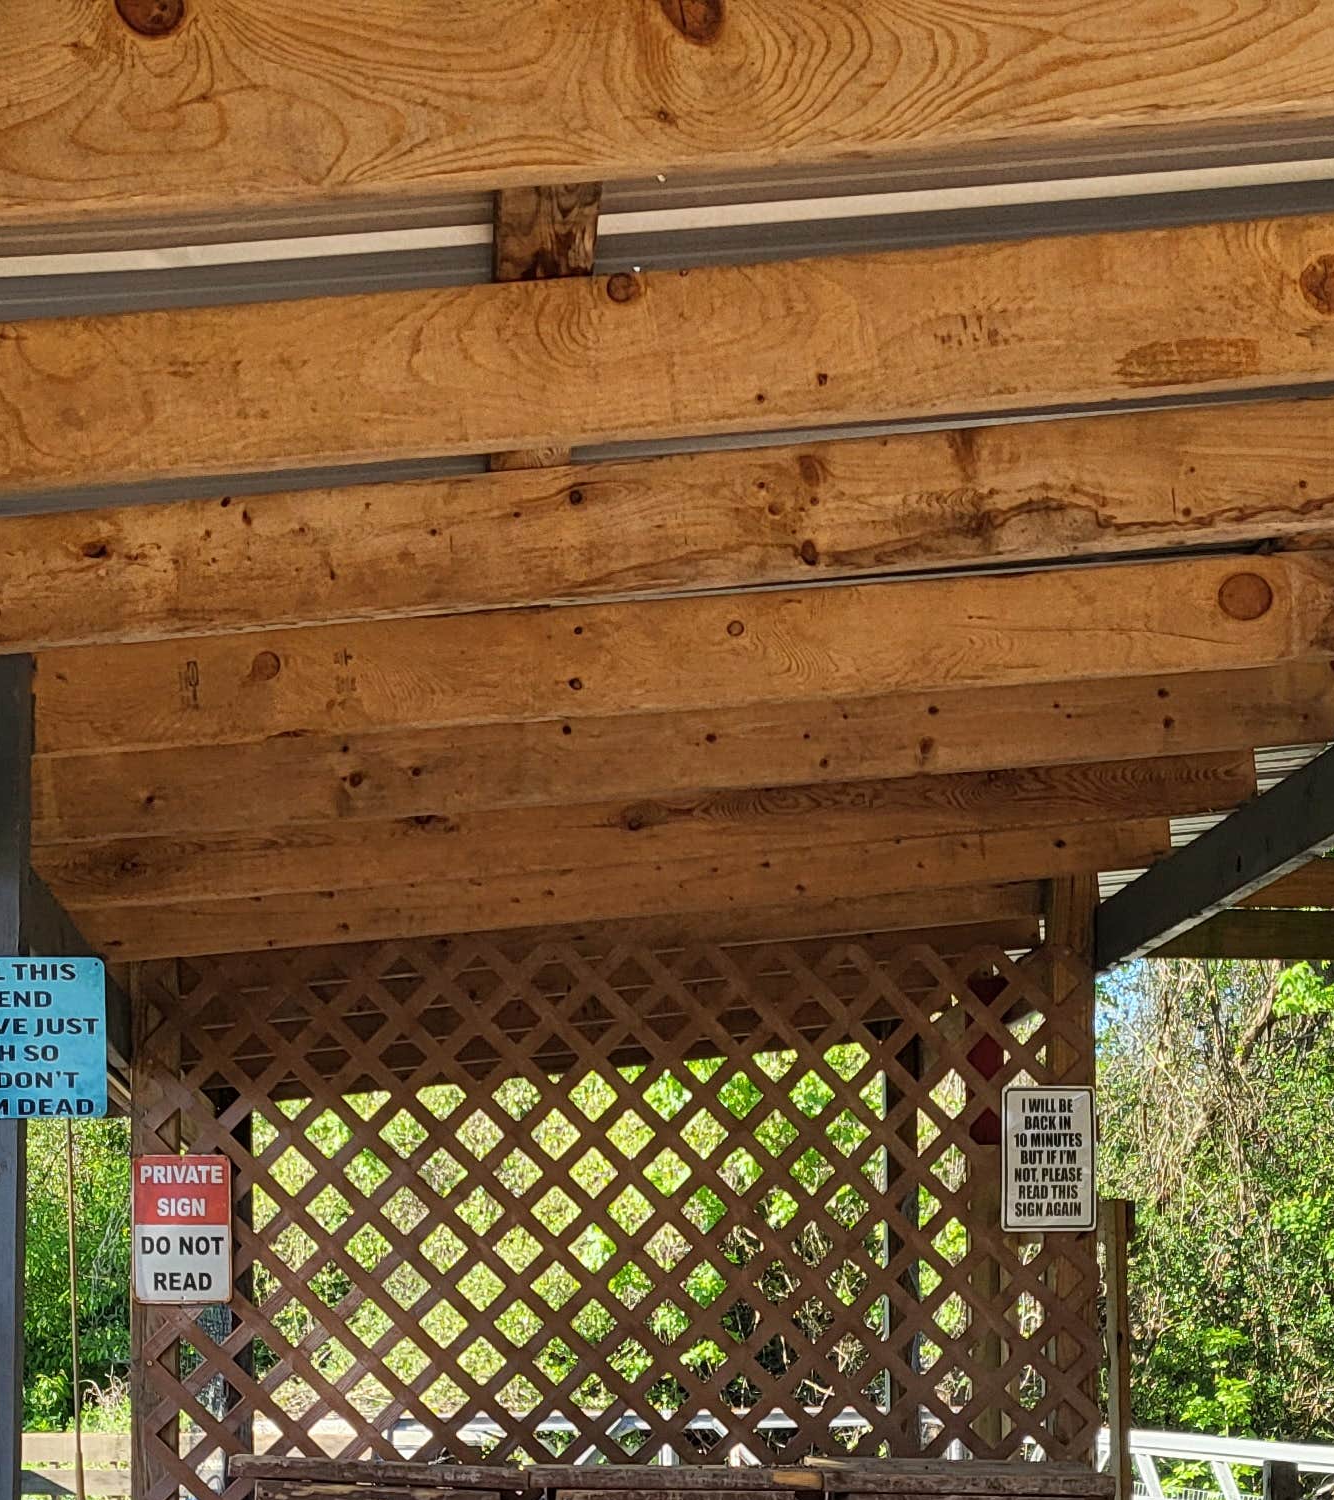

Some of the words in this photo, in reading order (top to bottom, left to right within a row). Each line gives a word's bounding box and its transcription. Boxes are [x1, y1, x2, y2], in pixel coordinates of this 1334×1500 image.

[12, 963, 76, 981] THIS
[34, 1018, 99, 1037] JUST
[24, 1045, 59, 1062] SO
[18, 1099, 94, 1116] DEAD
[1022, 1098, 1025, 1113] I
[1029, 1098, 1056, 1113] WILL
[1059, 1099, 1073, 1113] BE
[1025, 1116, 1056, 1130] BACK
[1059, 1116, 1071, 1130] IN
[1014, 1133, 1027, 1147] 10
[1031, 1133, 1082, 1147] MINUTES
[1021, 1150, 1044, 1164] BUT
[1047, 1150, 1056, 1164] IF
[140, 1165, 223, 1184] PRIVATE
[1015, 1168, 1038, 1183] NOT,
[1042, 1168, 1082, 1182] PLEASE
[1019, 1185, 1048, 1199] READ
[1051, 1185, 1078, 1199] THIS
[157, 1198, 206, 1217] SIGN
[1015, 1202, 1043, 1217] SIGN
[1046, 1202, 1081, 1216] AGAIN
[141, 1237, 170, 1254] DO
[179, 1237, 224, 1255] NOT
[154, 1273, 212, 1290] READ
